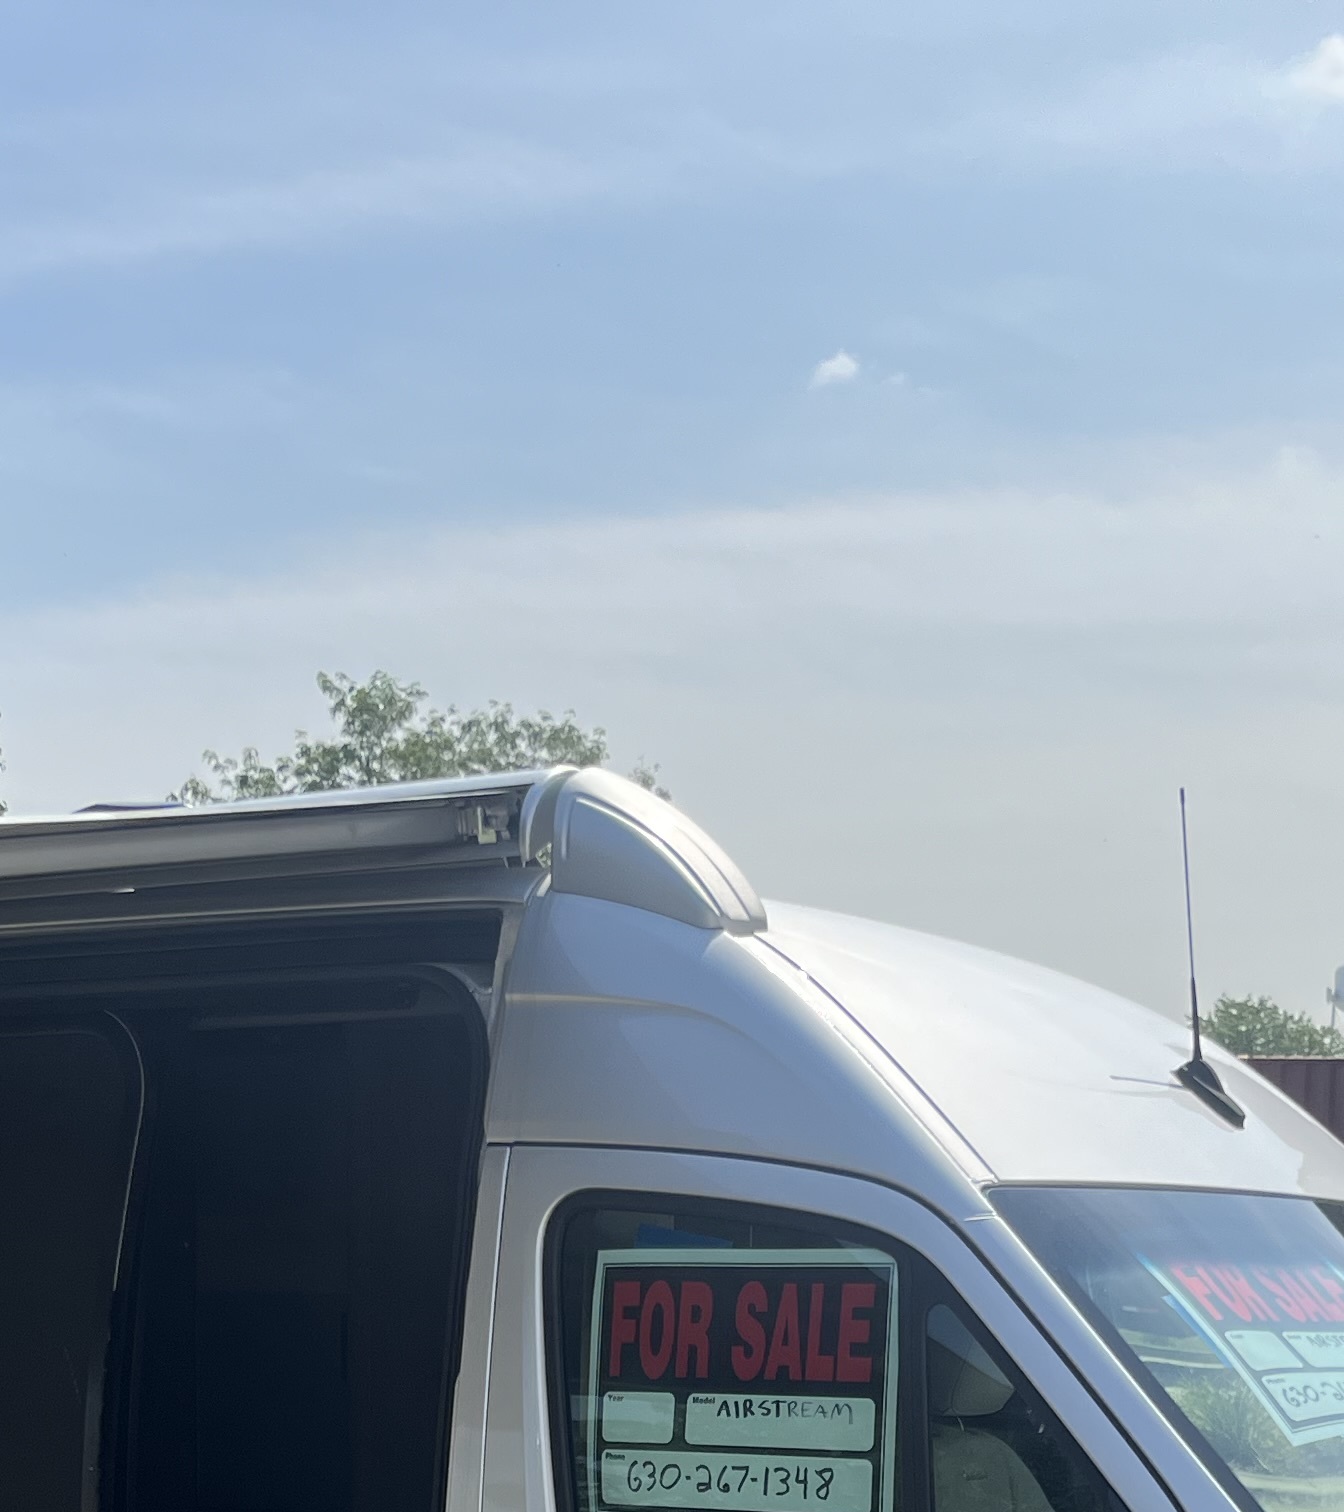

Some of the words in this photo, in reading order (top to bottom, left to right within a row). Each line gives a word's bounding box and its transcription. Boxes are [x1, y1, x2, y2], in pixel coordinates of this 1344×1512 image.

[609, 1279, 715, 1380] FOR
[730, 1280, 878, 1383] SALE
[607, 1394, 625, 1402] Year
[692, 1396, 716, 1405] Model
[716, 1400, 855, 1425] AIRSTREAM
[605, 1452, 626, 1462] Phone
[626, 1459, 835, 1501] 630-267-1348
